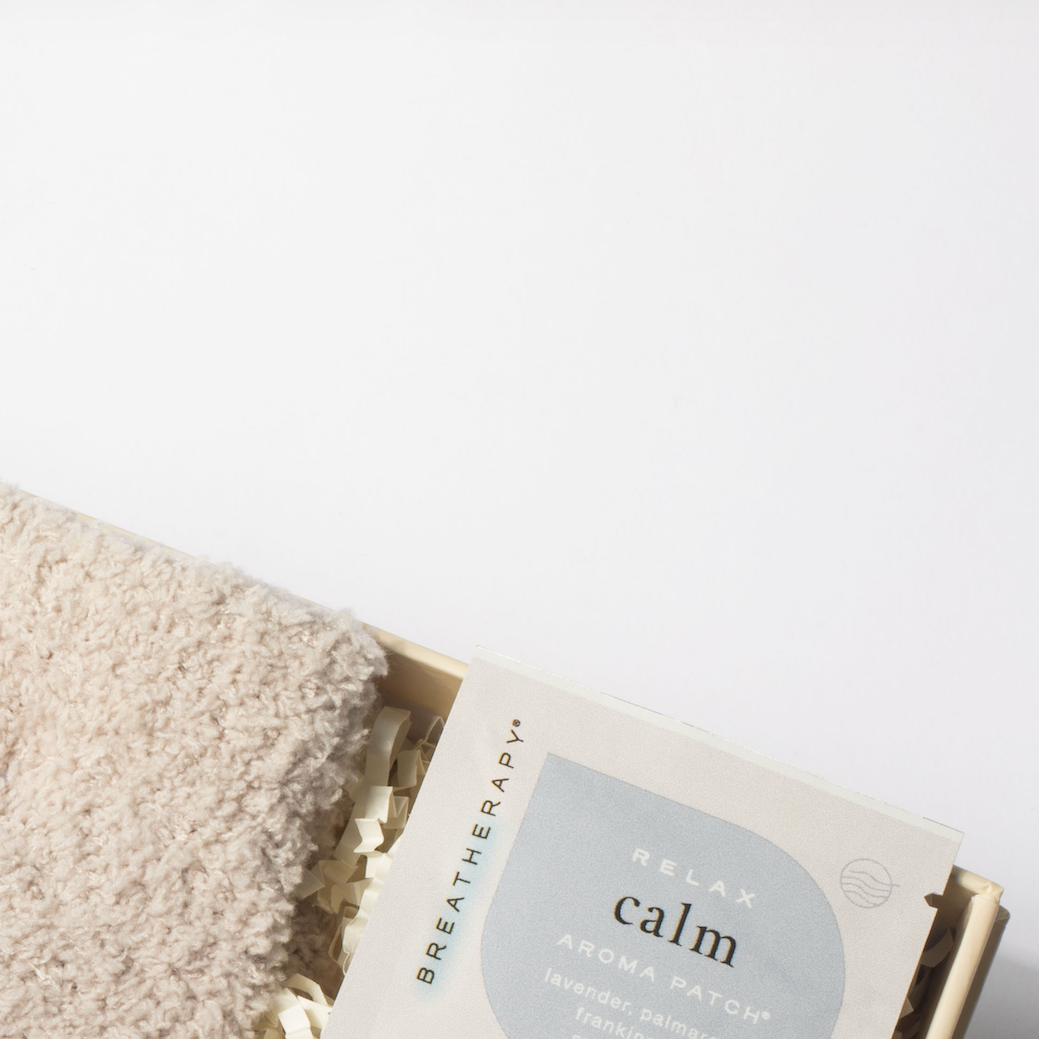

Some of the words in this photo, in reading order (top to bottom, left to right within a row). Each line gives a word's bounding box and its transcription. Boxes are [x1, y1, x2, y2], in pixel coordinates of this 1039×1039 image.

[632, 848, 756, 908] RELAX
[556, 934, 655, 982] AROMA
[614, 896, 737, 968] calm
[544, 967, 632, 1016] lavender,
